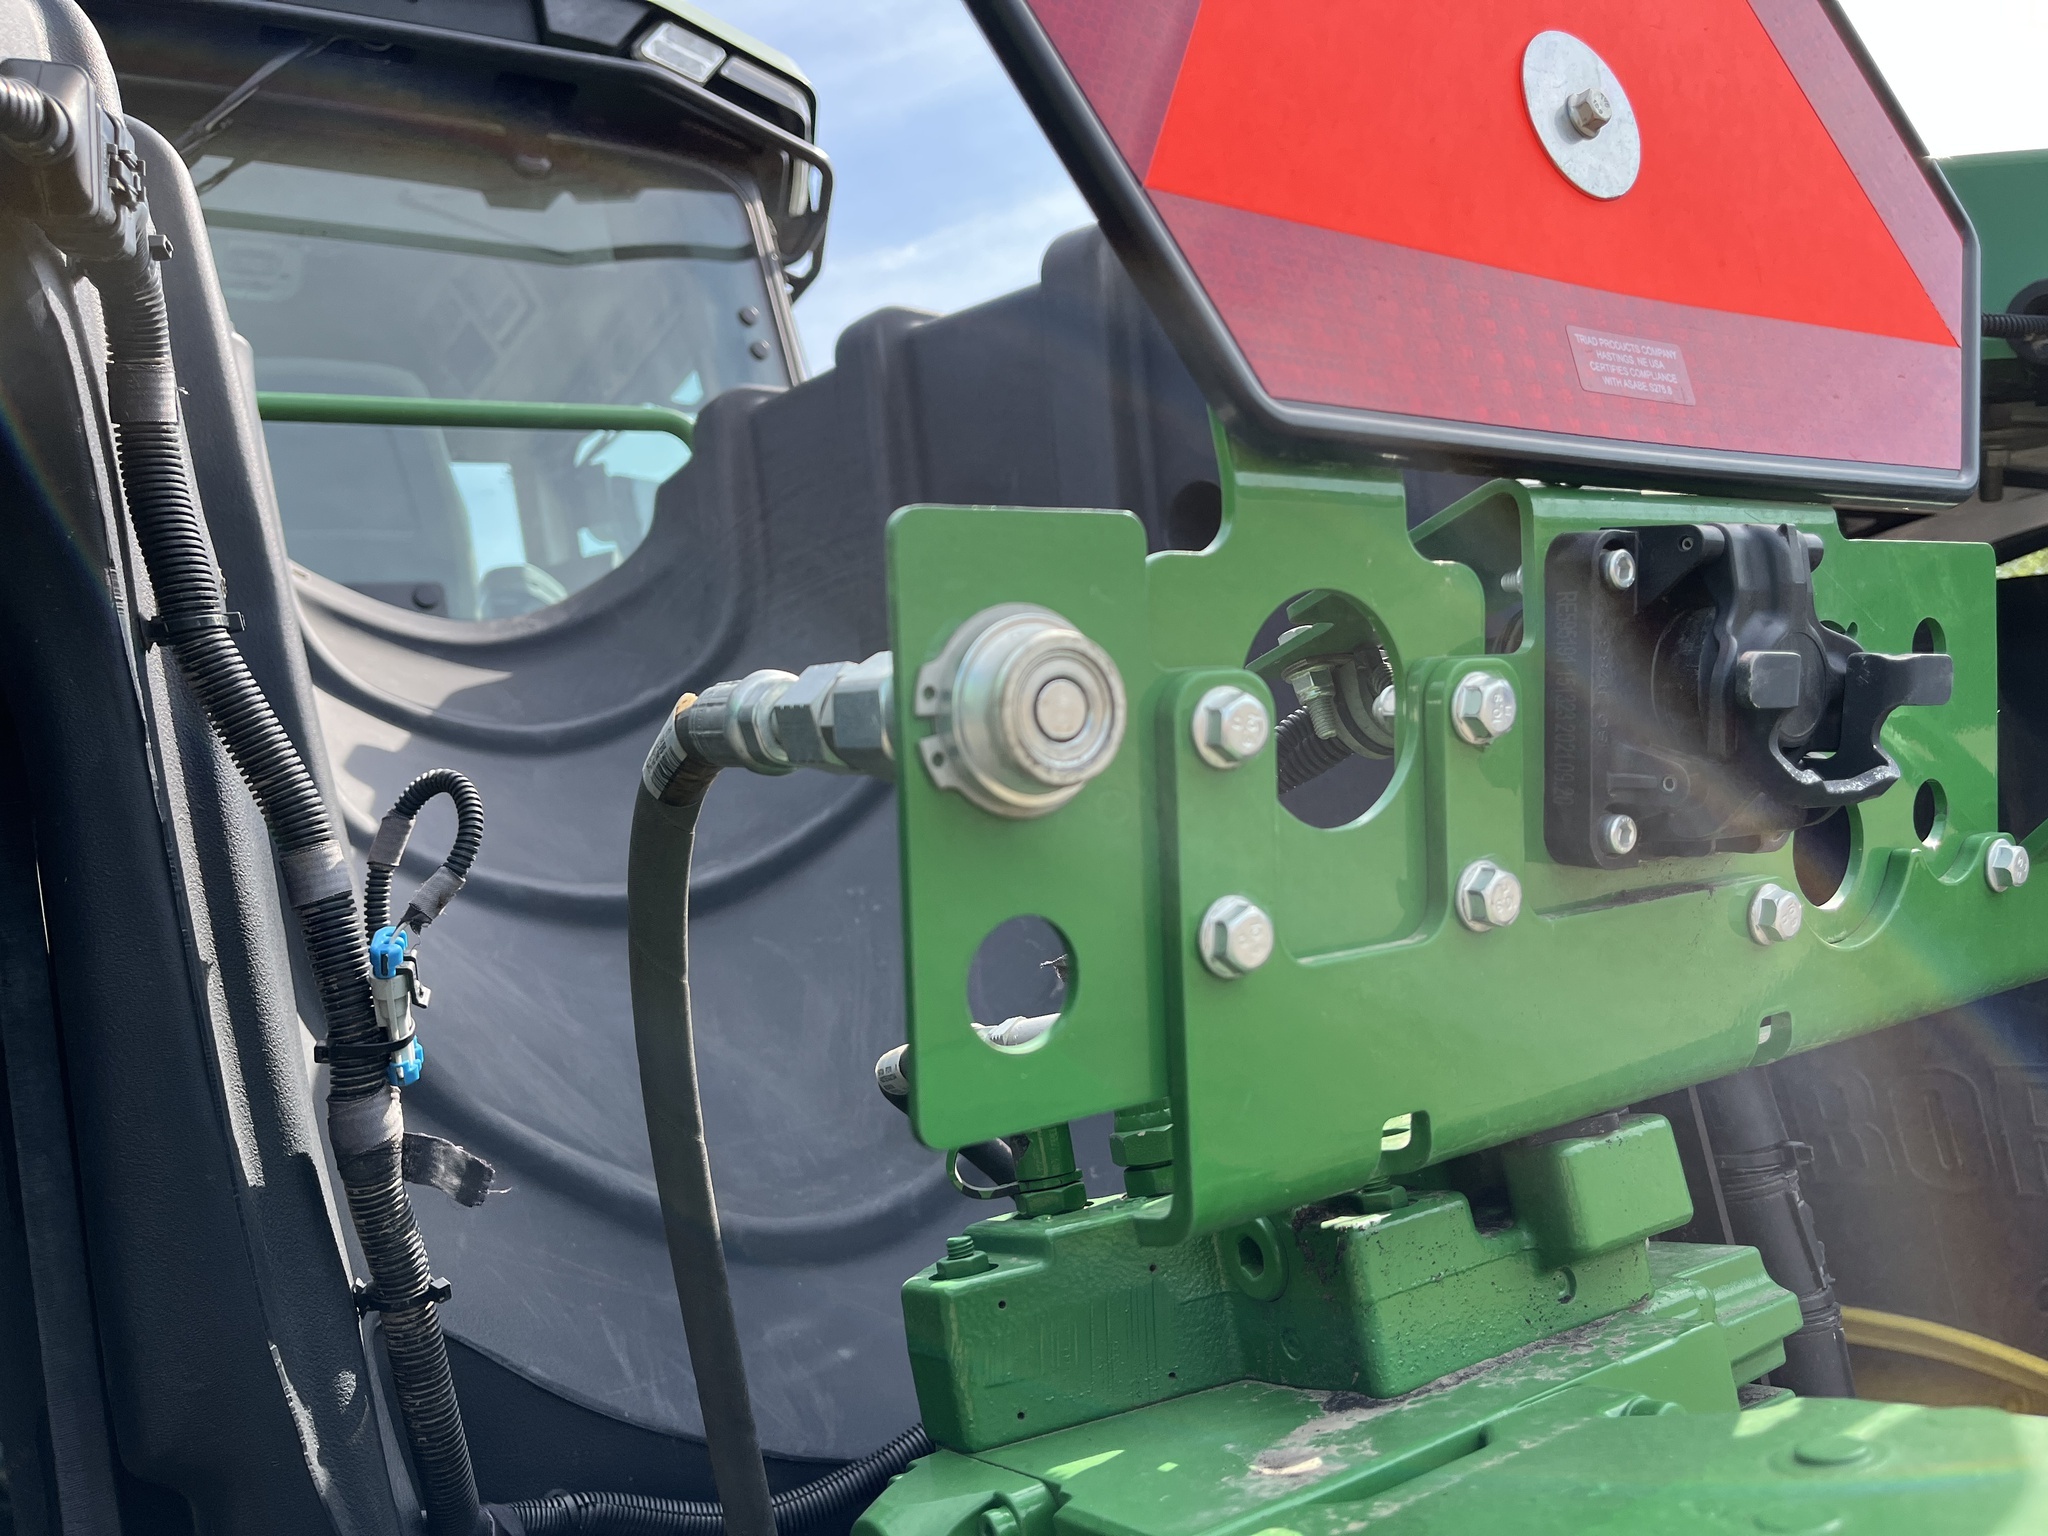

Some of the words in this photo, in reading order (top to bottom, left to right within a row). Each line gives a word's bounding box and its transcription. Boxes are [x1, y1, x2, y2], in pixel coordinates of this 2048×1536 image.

[1573, 333, 1598, 346] TRIAD
[1598, 337, 1641, 354] PRODUCTS
[1641, 345, 1677, 360] COMPANY
[1589, 360, 1629, 376] CERTIFIES
[1629, 367, 1679, 384] COMPLIANCE
[1637, 357, 1648, 367] NE
[1648, 359, 1665, 370] USA
[1601, 375, 1623, 388] WITH
[1623, 379, 1649, 392] ASABE
